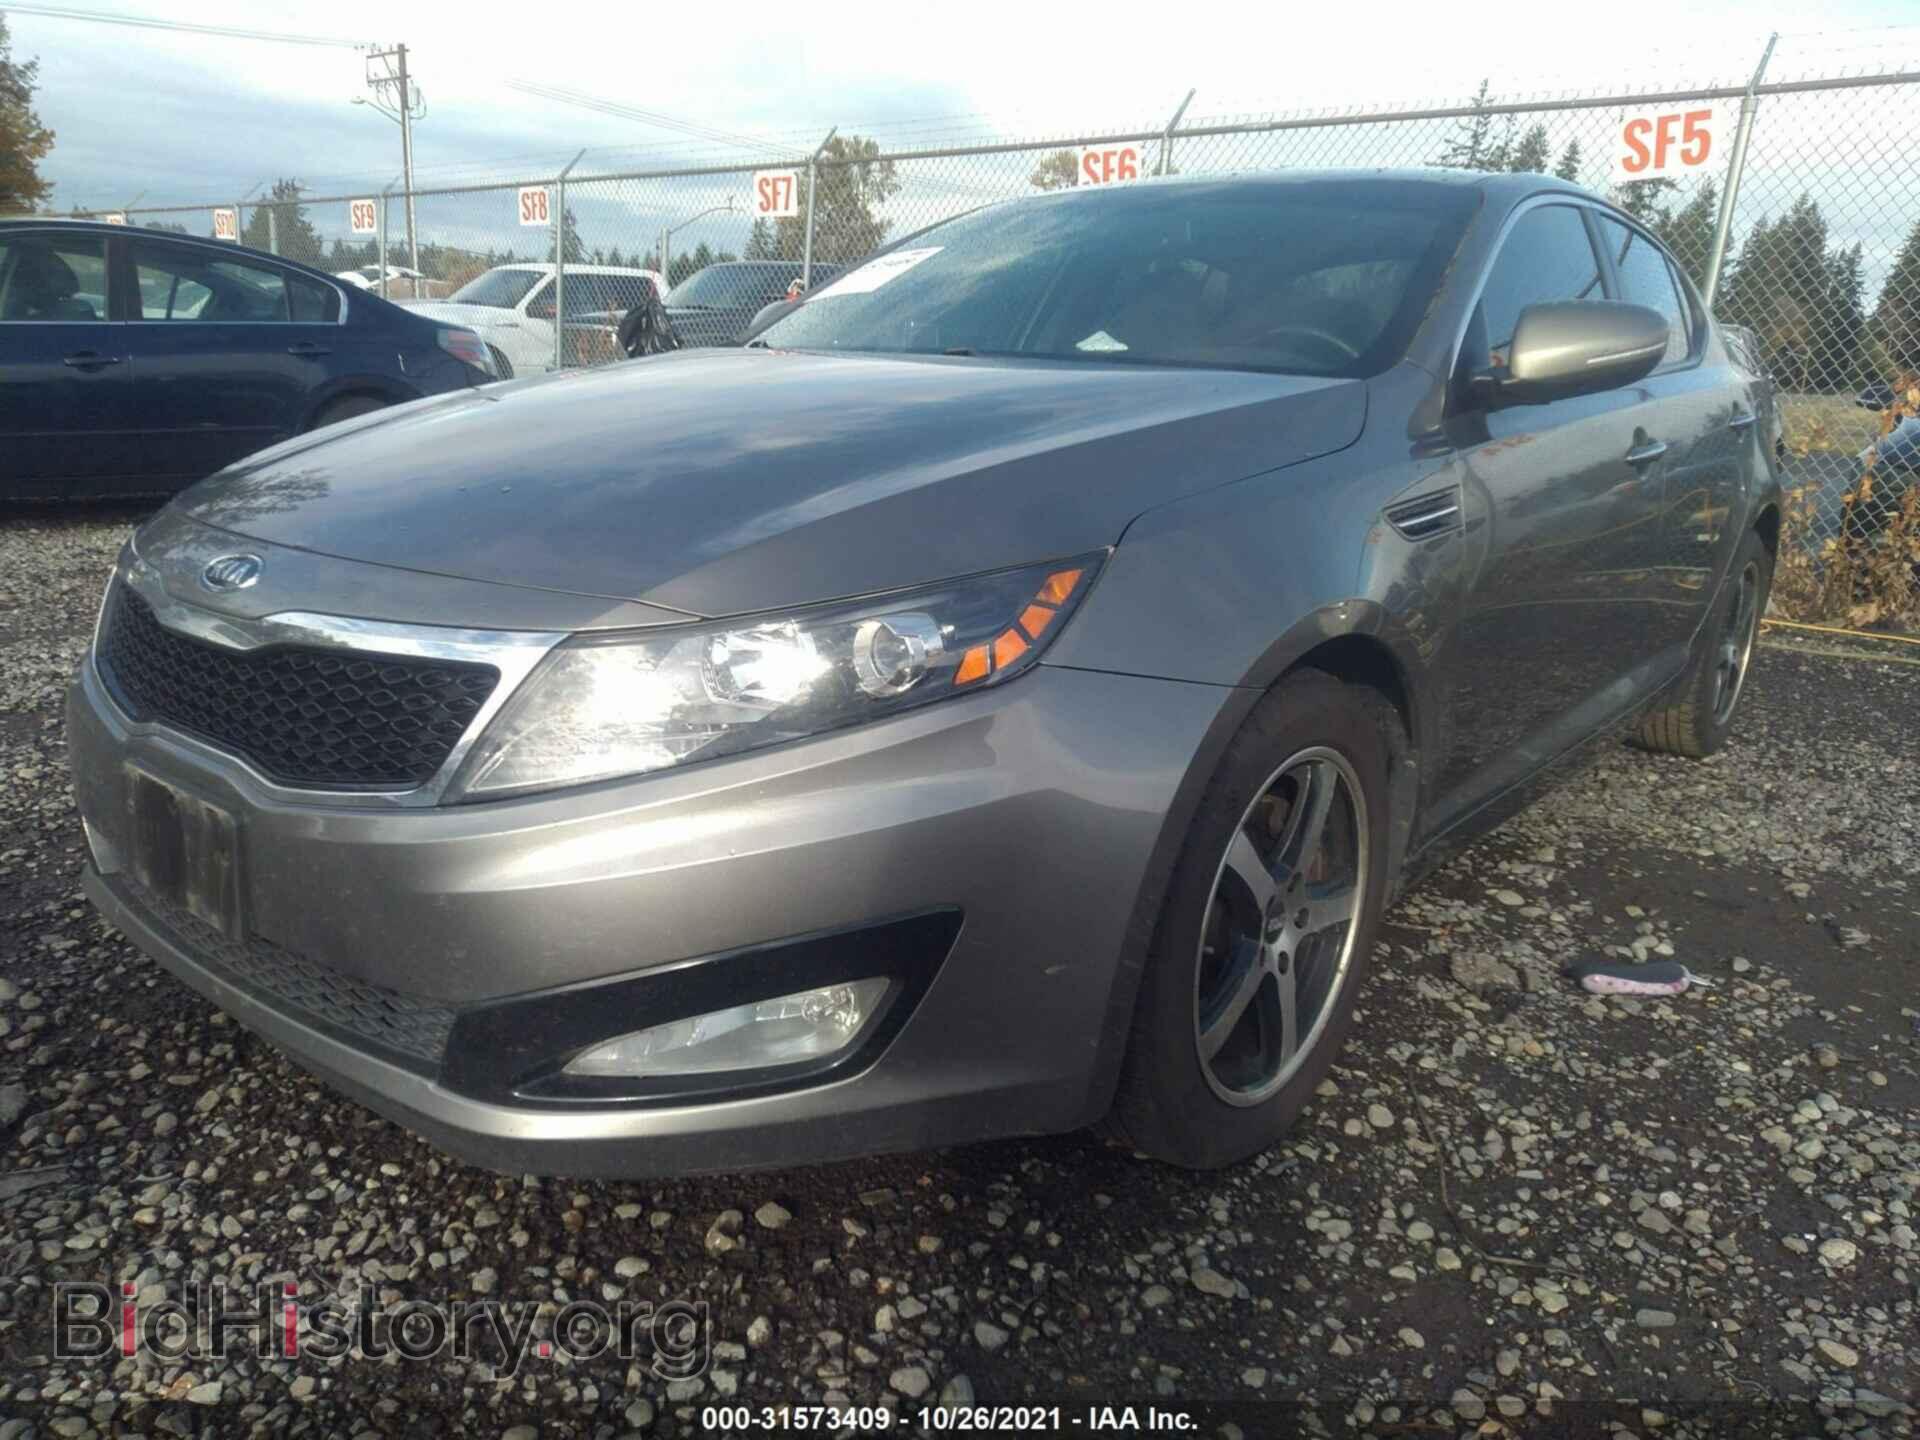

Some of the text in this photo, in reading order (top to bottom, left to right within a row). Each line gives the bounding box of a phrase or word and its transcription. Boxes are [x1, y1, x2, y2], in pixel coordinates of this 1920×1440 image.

[1622, 109, 1713, 173] SF5
[1082, 147, 1137, 185] SF6
[521, 191, 548, 221] SF8
[758, 176, 792, 212] SF7
[215, 213, 236, 237] SF10
[352, 203, 375, 229] SF9
